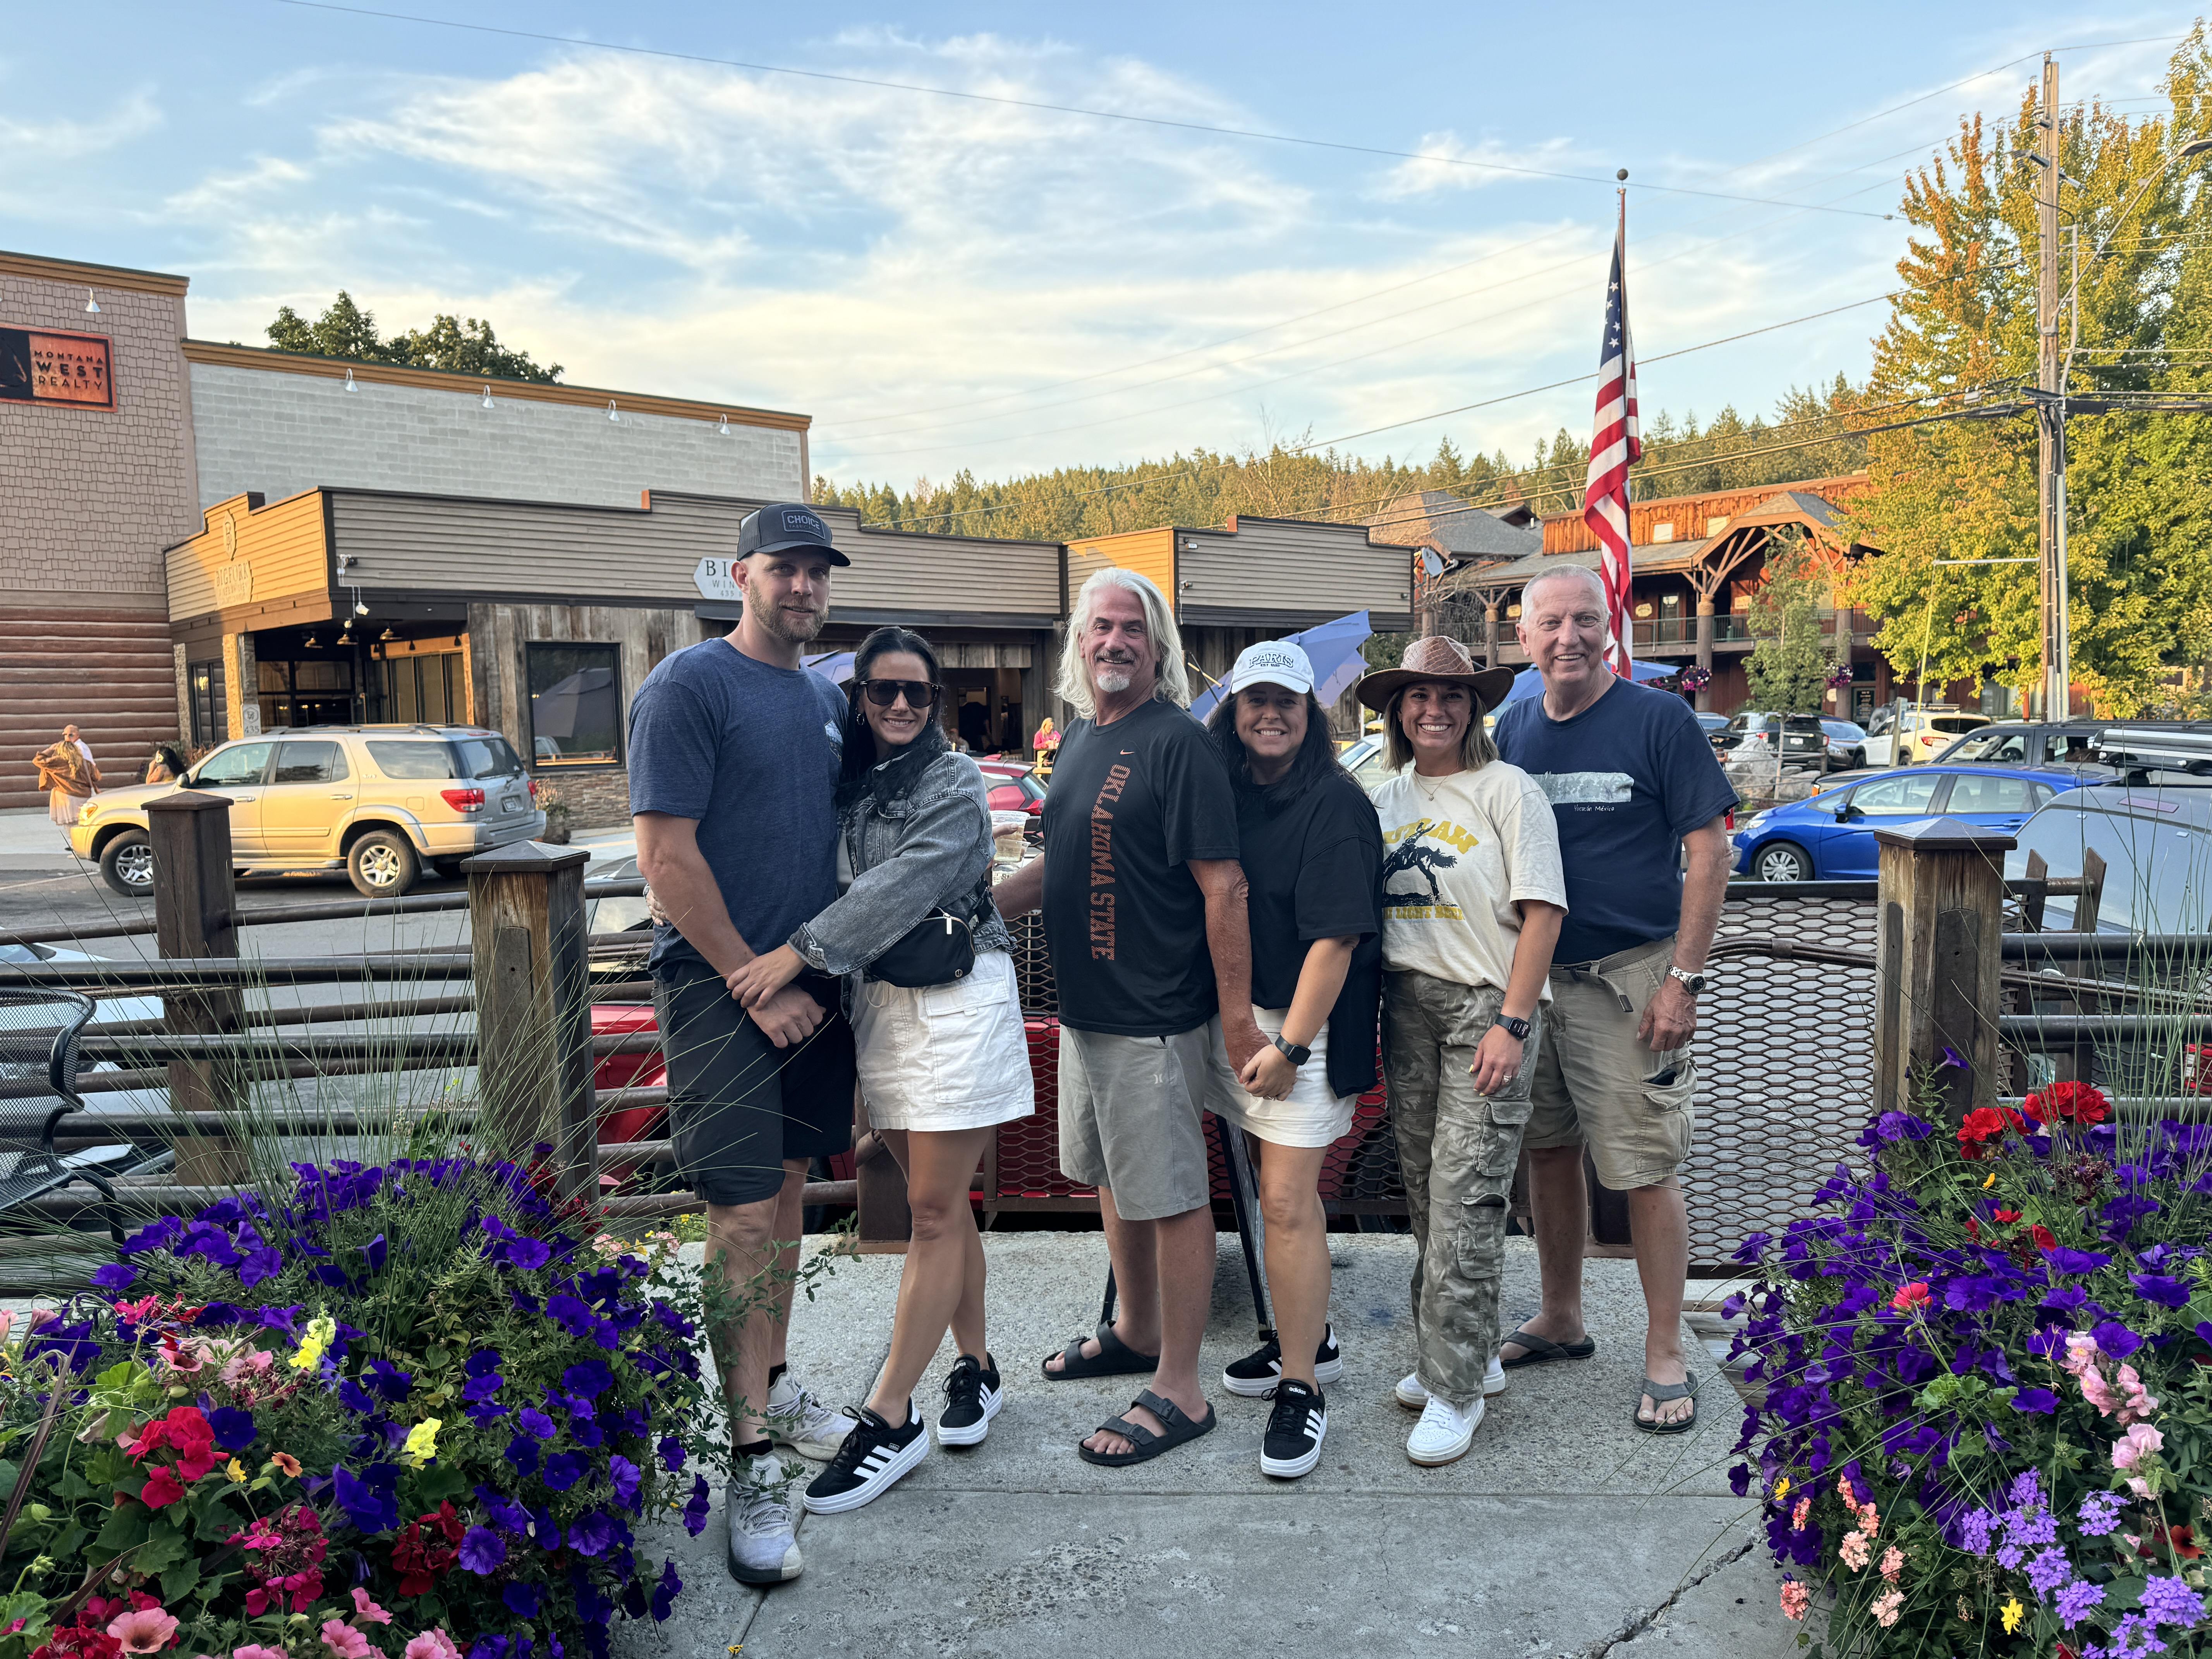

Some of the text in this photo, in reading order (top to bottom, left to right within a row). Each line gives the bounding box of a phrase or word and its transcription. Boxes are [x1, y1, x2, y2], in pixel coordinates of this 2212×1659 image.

[34, 350, 103, 364] MONTANA
[36, 361, 103, 378] WEST
[38, 376, 102, 390] REALTY
[787, 515, 820, 530] CHOICE
[216, 562, 248, 587] BIGFORK
[705, 560, 729, 577] BI
[712, 580, 735, 589] WIN
[1249, 653, 1294, 668] PARIS
[245, 725, 260, 734] 435
[1383, 818, 1479, 855] UTLAW
[1090, 764, 1131, 960] OKLAHOMA STATE
[1396, 906, 1432, 919] LIGHT
[1289, 1387, 1307, 1395] adidas
